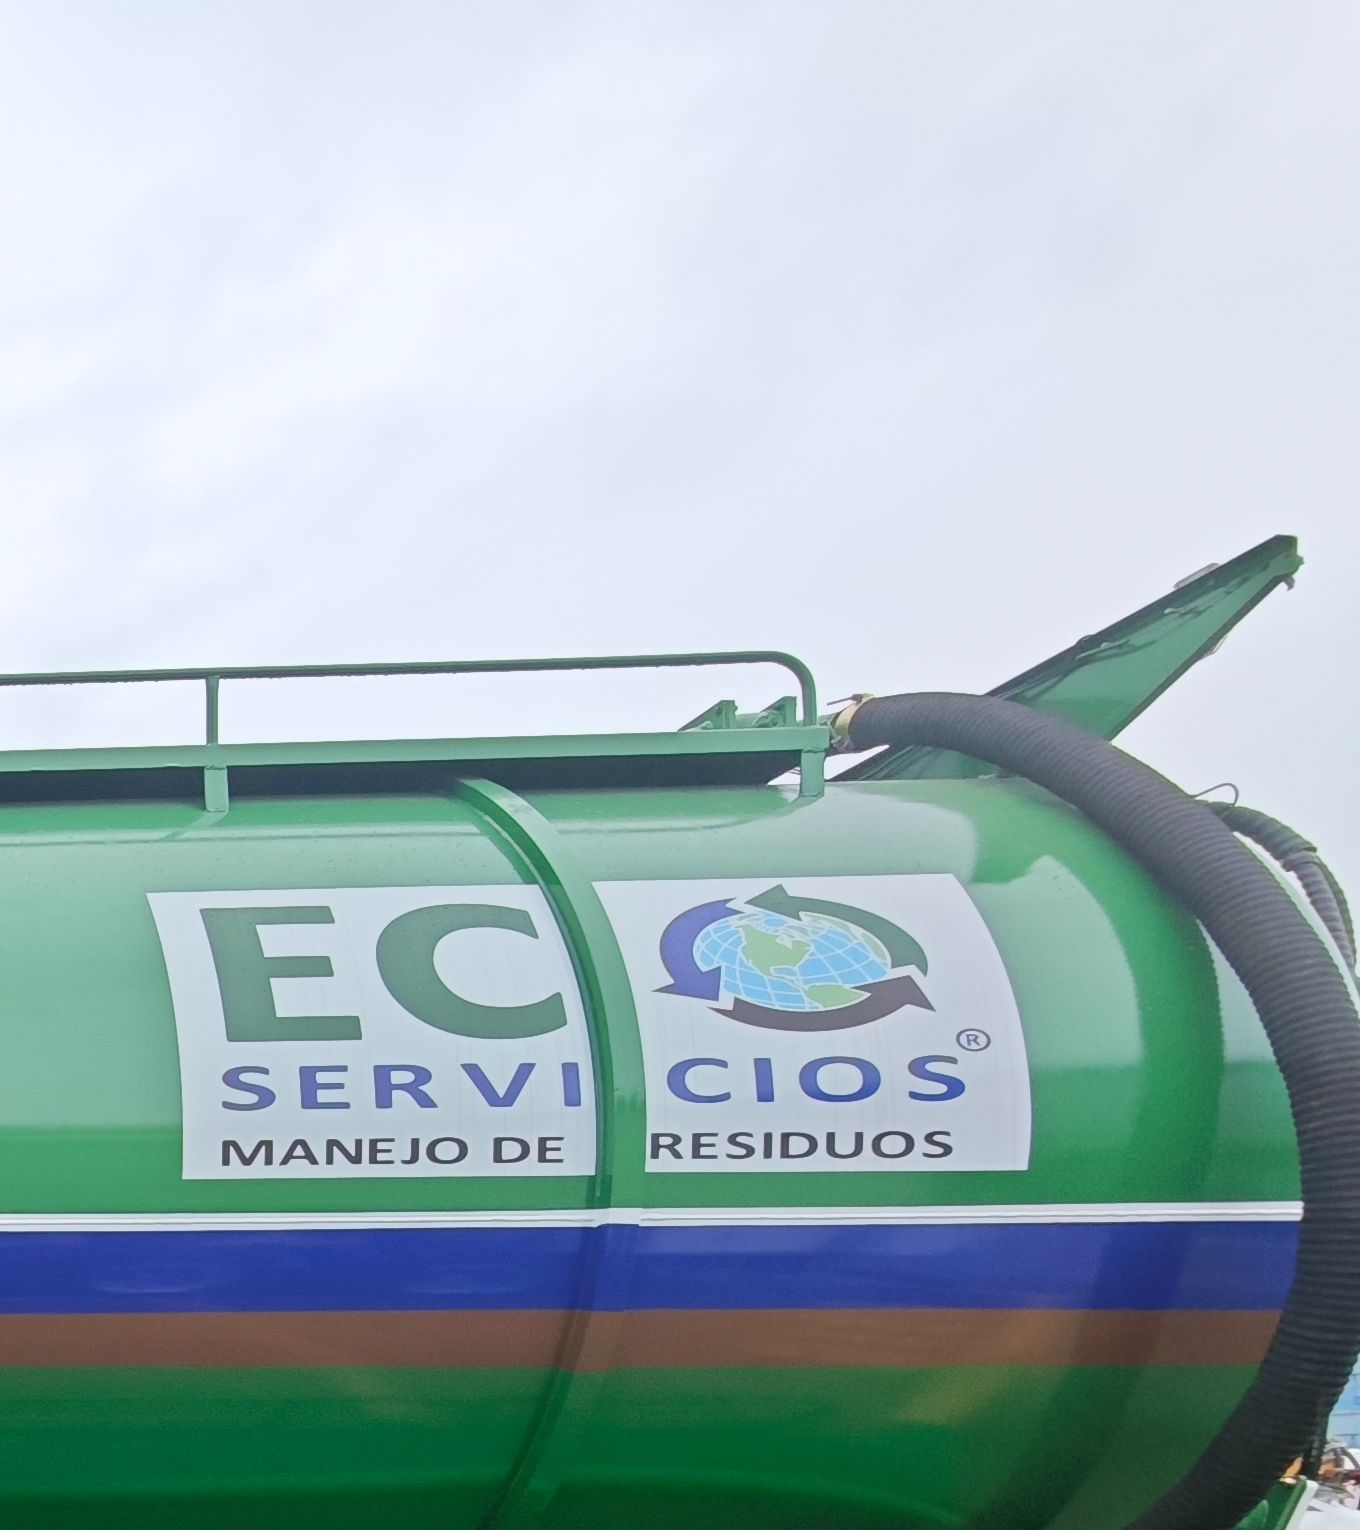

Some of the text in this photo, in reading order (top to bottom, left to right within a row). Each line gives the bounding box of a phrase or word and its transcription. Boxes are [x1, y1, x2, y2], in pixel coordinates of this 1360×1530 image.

[220, 1129, 955, 1168] MANEJO DE RESIDUOS
